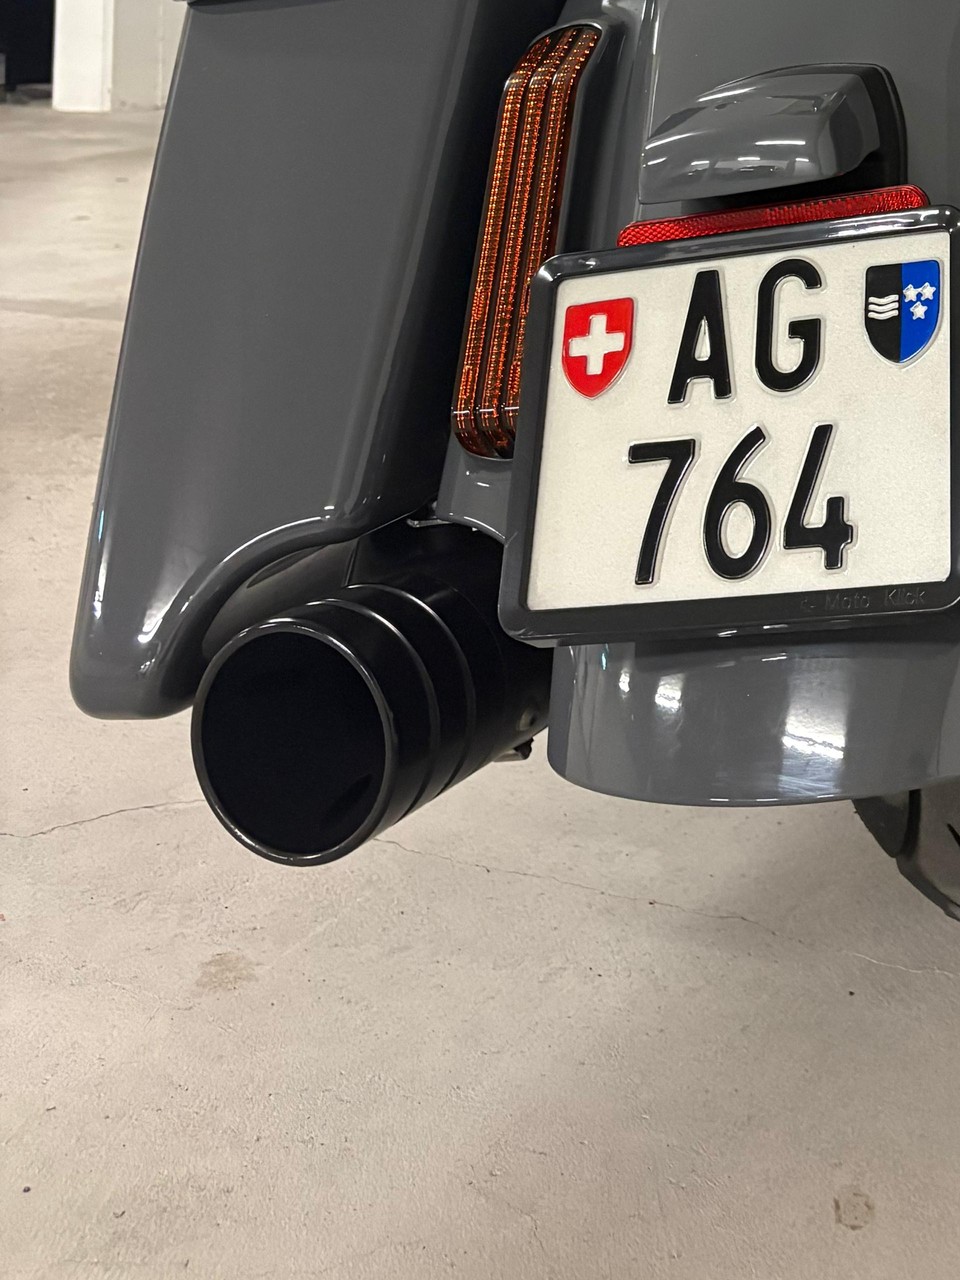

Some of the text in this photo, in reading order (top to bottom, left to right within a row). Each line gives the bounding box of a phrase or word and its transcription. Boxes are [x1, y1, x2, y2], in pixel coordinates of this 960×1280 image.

[667, 258, 822, 405] AG
[628, 424, 854, 586] 764
[825, 592, 870, 610] Moto
